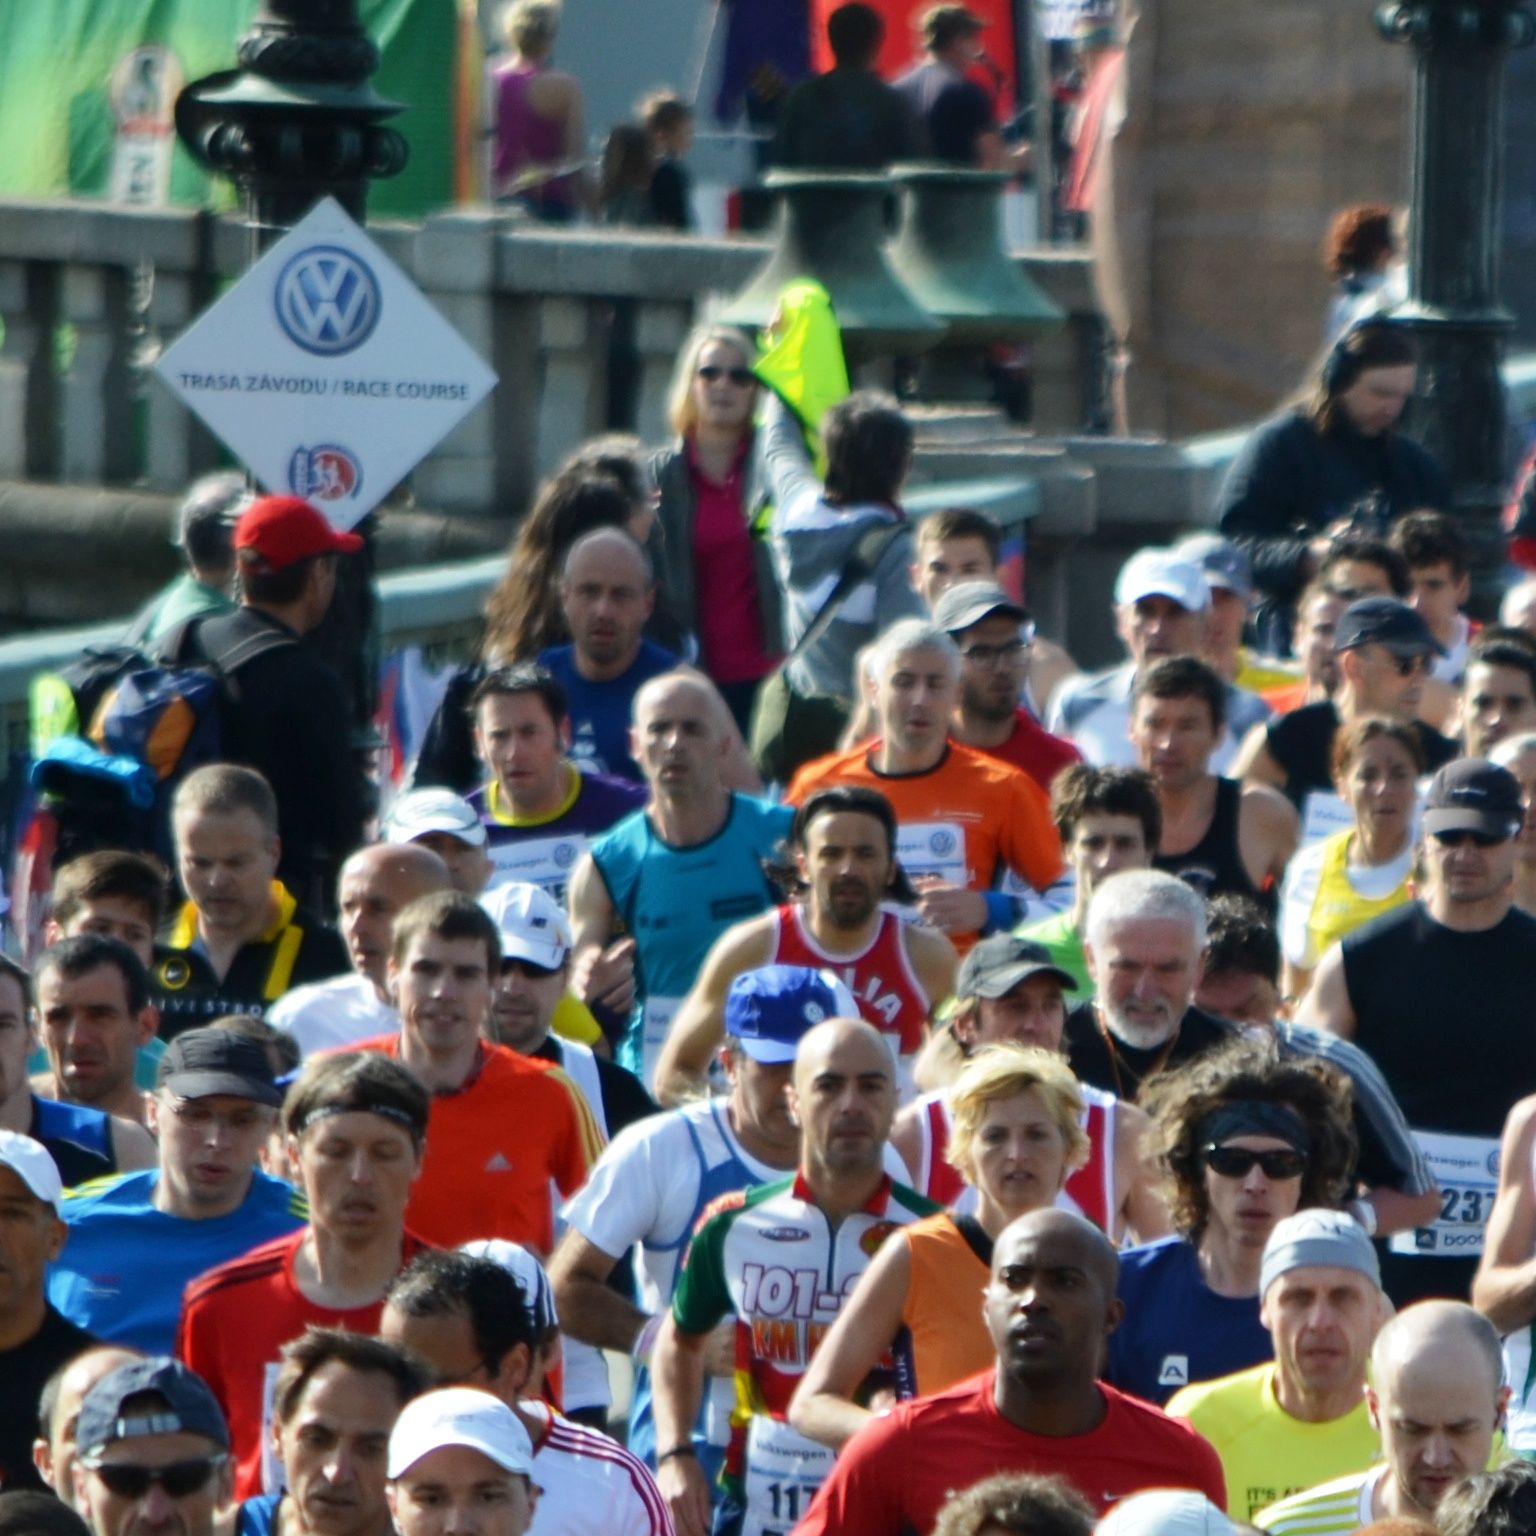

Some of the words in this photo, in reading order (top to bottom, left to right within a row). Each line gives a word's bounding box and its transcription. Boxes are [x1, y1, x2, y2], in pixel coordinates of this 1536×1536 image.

[179, 373, 241, 392] TRASA
[248, 373, 328, 395] ZÁVODU
[343, 380, 391, 398] RACE
[395, 382, 470, 400] COURSE
